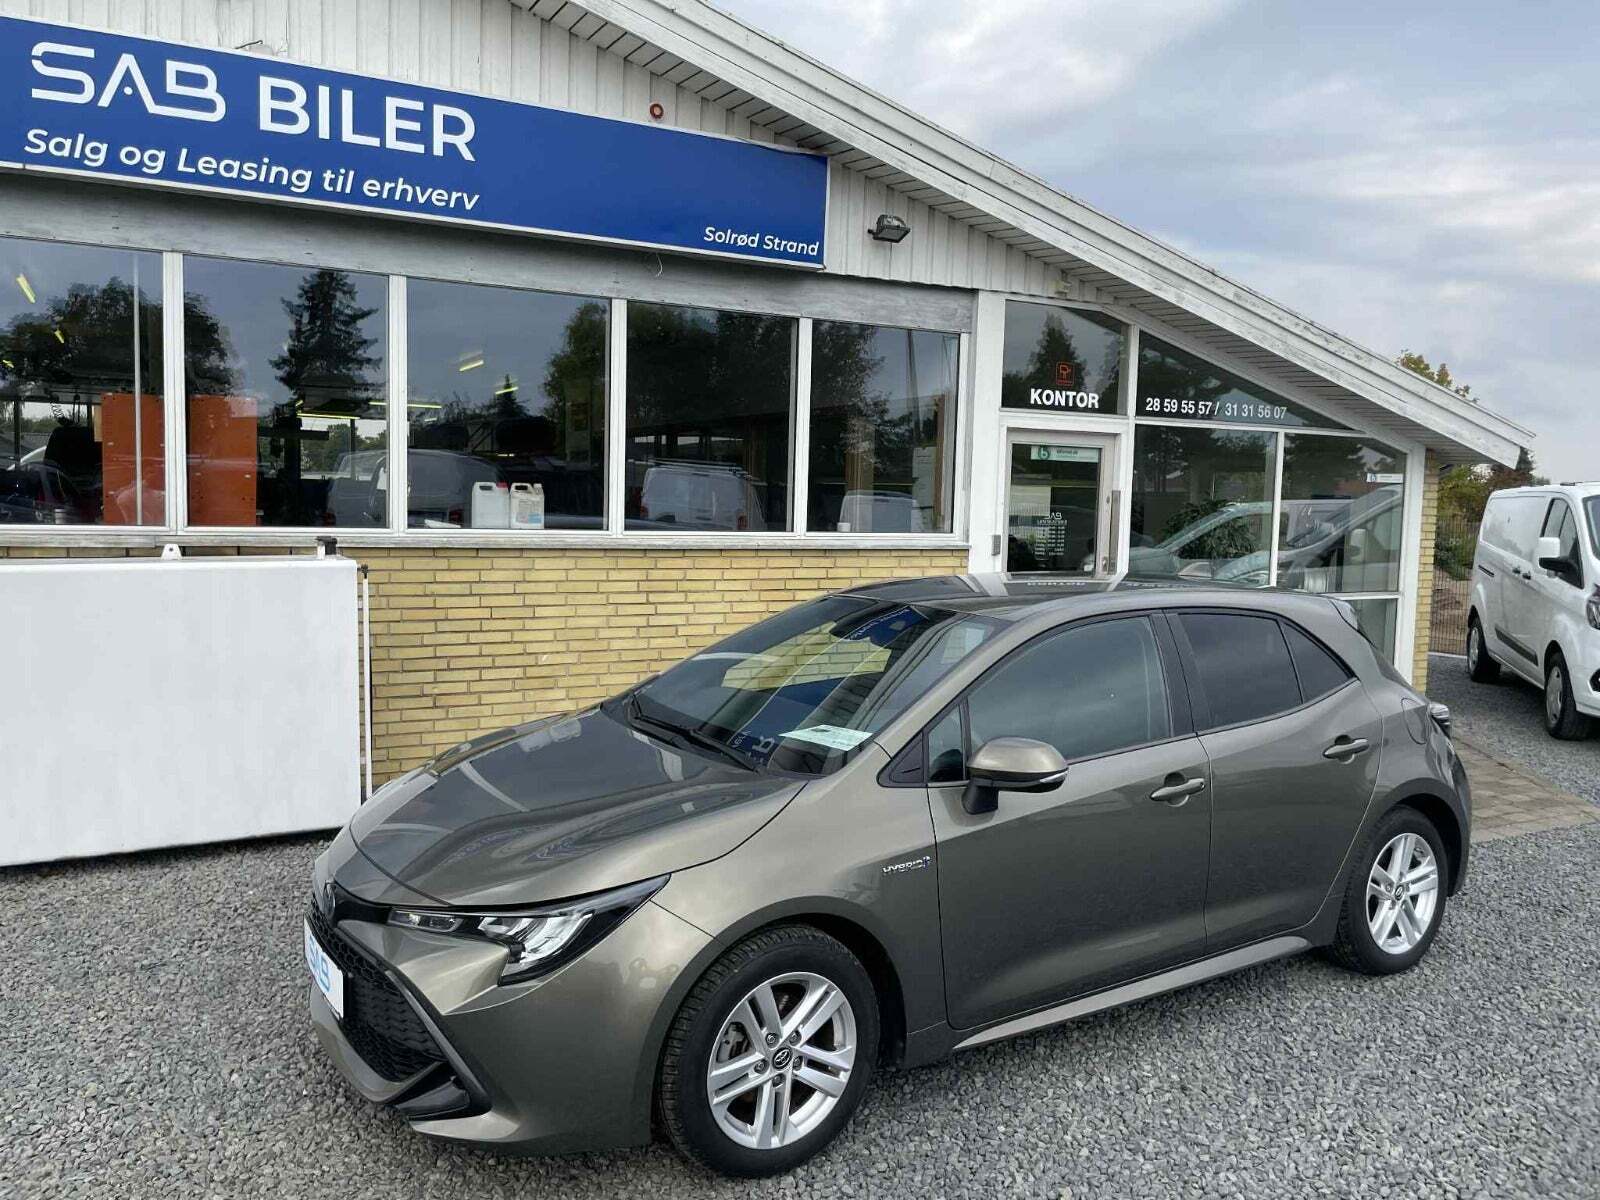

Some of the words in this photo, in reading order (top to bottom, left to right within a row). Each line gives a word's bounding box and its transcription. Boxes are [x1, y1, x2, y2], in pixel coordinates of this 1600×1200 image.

[31, 41, 226, 123] SAB
[259, 75, 476, 162] BILER
[24, 128, 109, 167] Salg
[119, 146, 166, 175] og
[177, 148, 313, 193] Leasing
[322, 168, 355, 194] til
[362, 177, 480, 210] erhverv
[703, 226, 760, 248] Solrød
[763, 235, 820, 256] Strand
[1030, 388, 1100, 409] KONTOR
[1145, 397, 1161, 412] 28
[1163, 398, 1178, 413] 59
[1180, 399, 1196, 414] 55
[1197, 401, 1213, 415] 57
[1224, 402, 1238, 417] 31
[1241, 403, 1254, 417] 31
[1257, 404, 1272, 418] 56
[1273, 406, 1287, 420] 07
